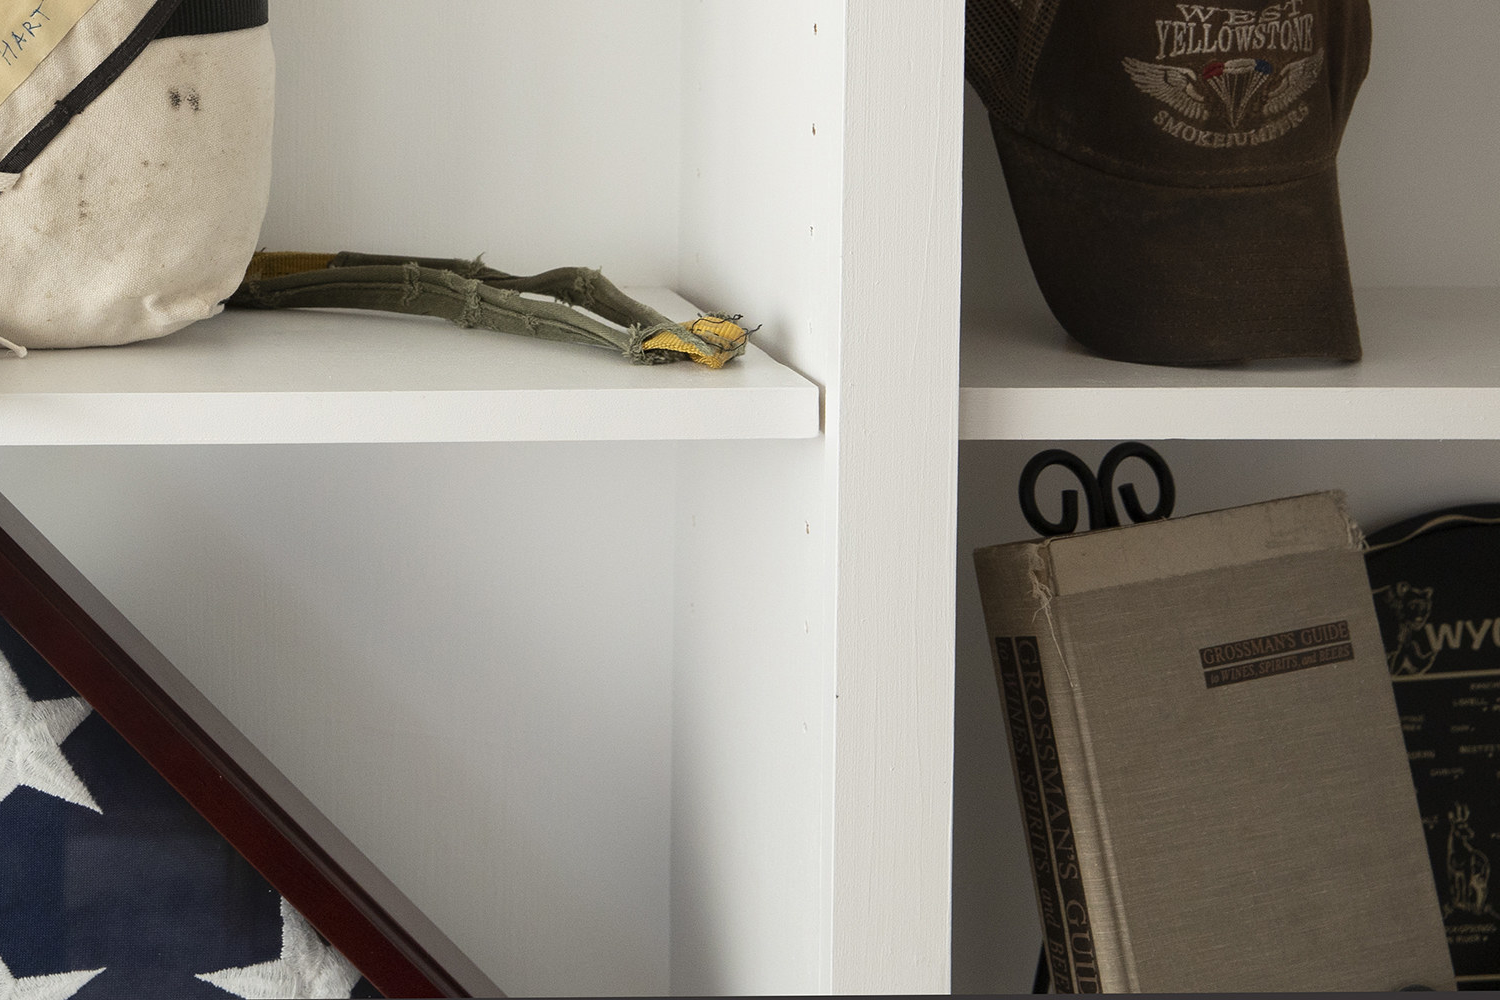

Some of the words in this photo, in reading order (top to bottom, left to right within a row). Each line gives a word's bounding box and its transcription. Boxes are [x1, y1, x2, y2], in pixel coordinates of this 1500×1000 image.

[1155, 13, 1315, 60] YELLOWSTONE
[1152, 104, 1309, 149] SMOKEJUMPERS
[1202, 631, 1298, 665] GROSSMAN'S
[1300, 621, 1350, 646] GUIDE
[1300, 653, 1318, 667] and
[1320, 646, 1351, 662] BEERS
[1018, 640, 1079, 882] GROSSMAN'S
[1039, 888, 1060, 928] and
